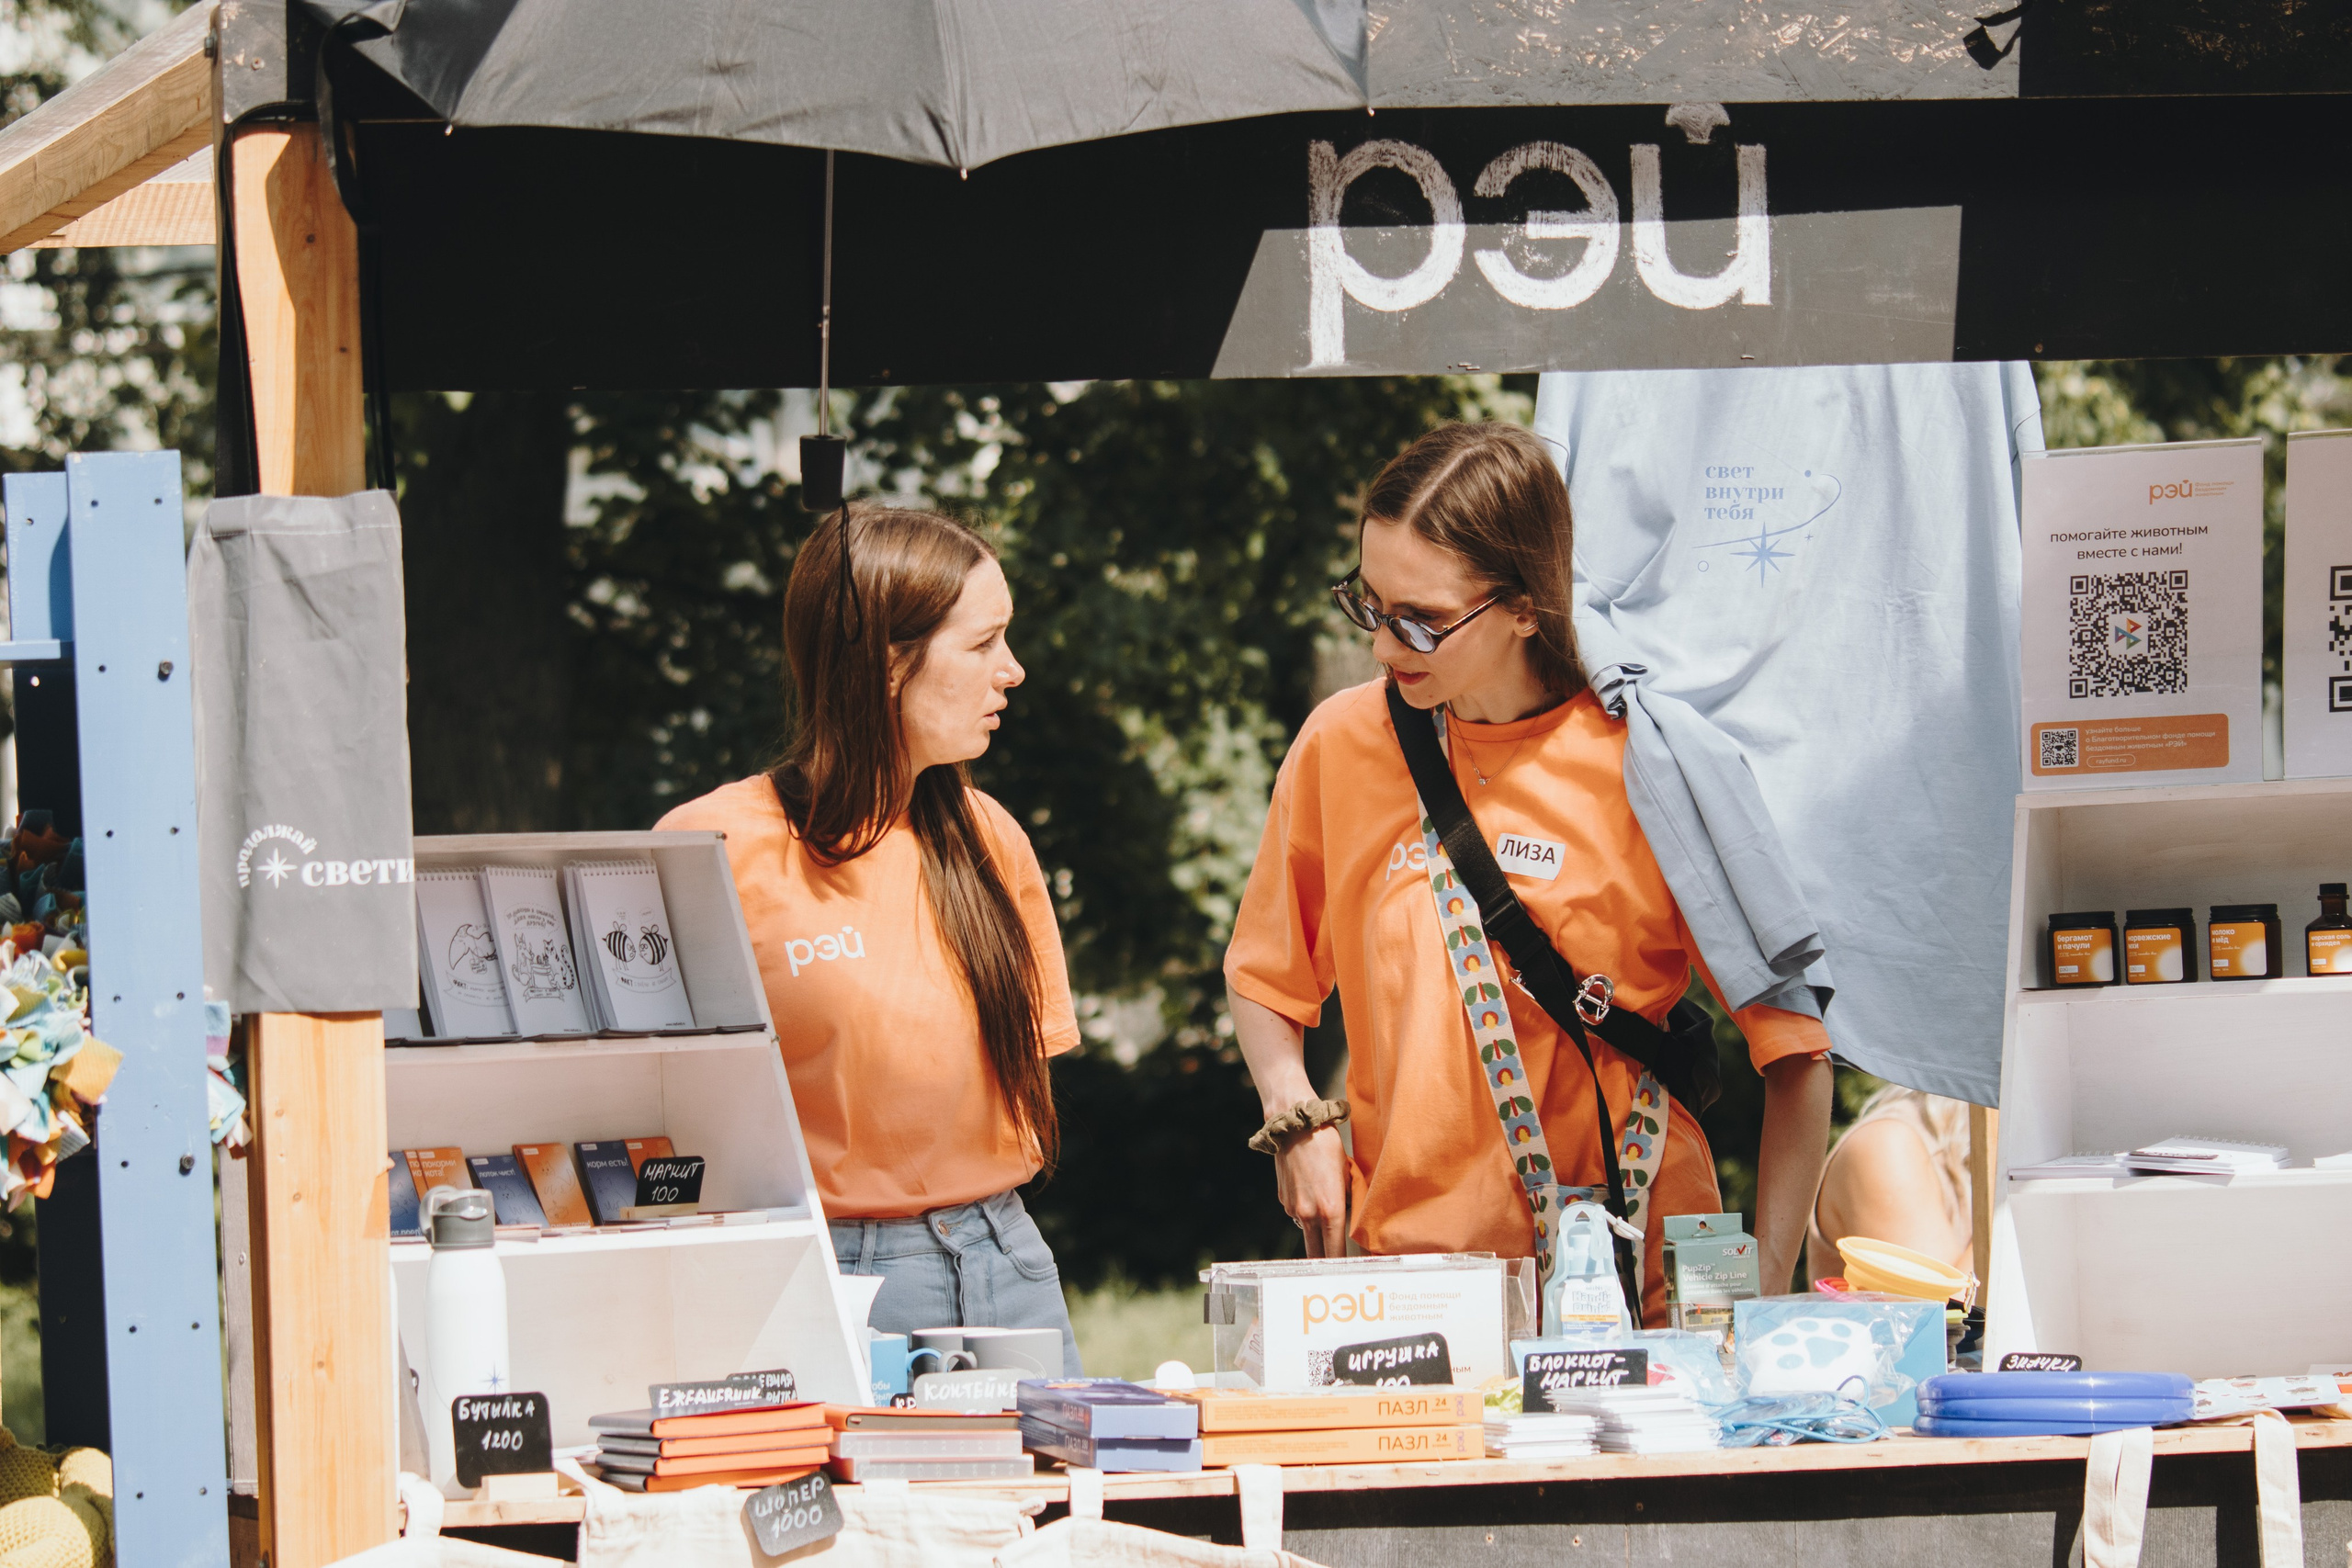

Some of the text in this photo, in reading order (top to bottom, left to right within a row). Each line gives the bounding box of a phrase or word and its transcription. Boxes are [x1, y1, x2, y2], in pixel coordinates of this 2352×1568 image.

[1307, 103, 1770, 367] рэй
[1705, 465, 1754, 479] свет
[1705, 485, 1784, 503] внутри
[2149, 479, 2193, 505] рэй
[1704, 503, 1754, 520] тебя
[2050, 525, 2208, 542] помогайте животным
[2077, 543, 2183, 559] вместе с нами!
[237, 823, 318, 889] продолжай
[1500, 839, 1556, 864] ЛИЗА
[1385, 841, 1430, 881] рэ
[300, 857, 415, 887] свети
[2057, 933, 2093, 943] бергамот
[2063, 942, 2090, 951] пачули
[2128, 933, 2171, 942] норвежские
[785, 925, 865, 977] рэй
[423, 1159, 457, 1168] покорми
[586, 1157, 629, 1169] корм есть!
[645, 1161, 707, 1181] МАГНИТ
[425, 1169, 446, 1178] кота!
[651, 1186, 679, 1201] 100
[1683, 1273, 1713, 1281] Vehicle
[1303, 1285, 1462, 1335] рэй Фонд помощи
[1389, 1302, 1449, 1312] бездомным
[1389, 1313, 1443, 1322] животным
[1348, 1341, 1440, 1372] ИГРУШКА
[458, 1397, 536, 1422] БУТЫЛКА
[1062, 1404, 1079, 1422] ПАЗЛ
[1378, 1397, 1447, 1416] ПАЗЛ 24
[481, 1430, 524, 1450] 1200
[1066, 1435, 1081, 1453] ПАЗЛ
[1379, 1433, 1447, 1450] ПАЗЛ 24
[754, 1476, 825, 1517] ШОПЕР
[771, 1504, 823, 1540] 1000
